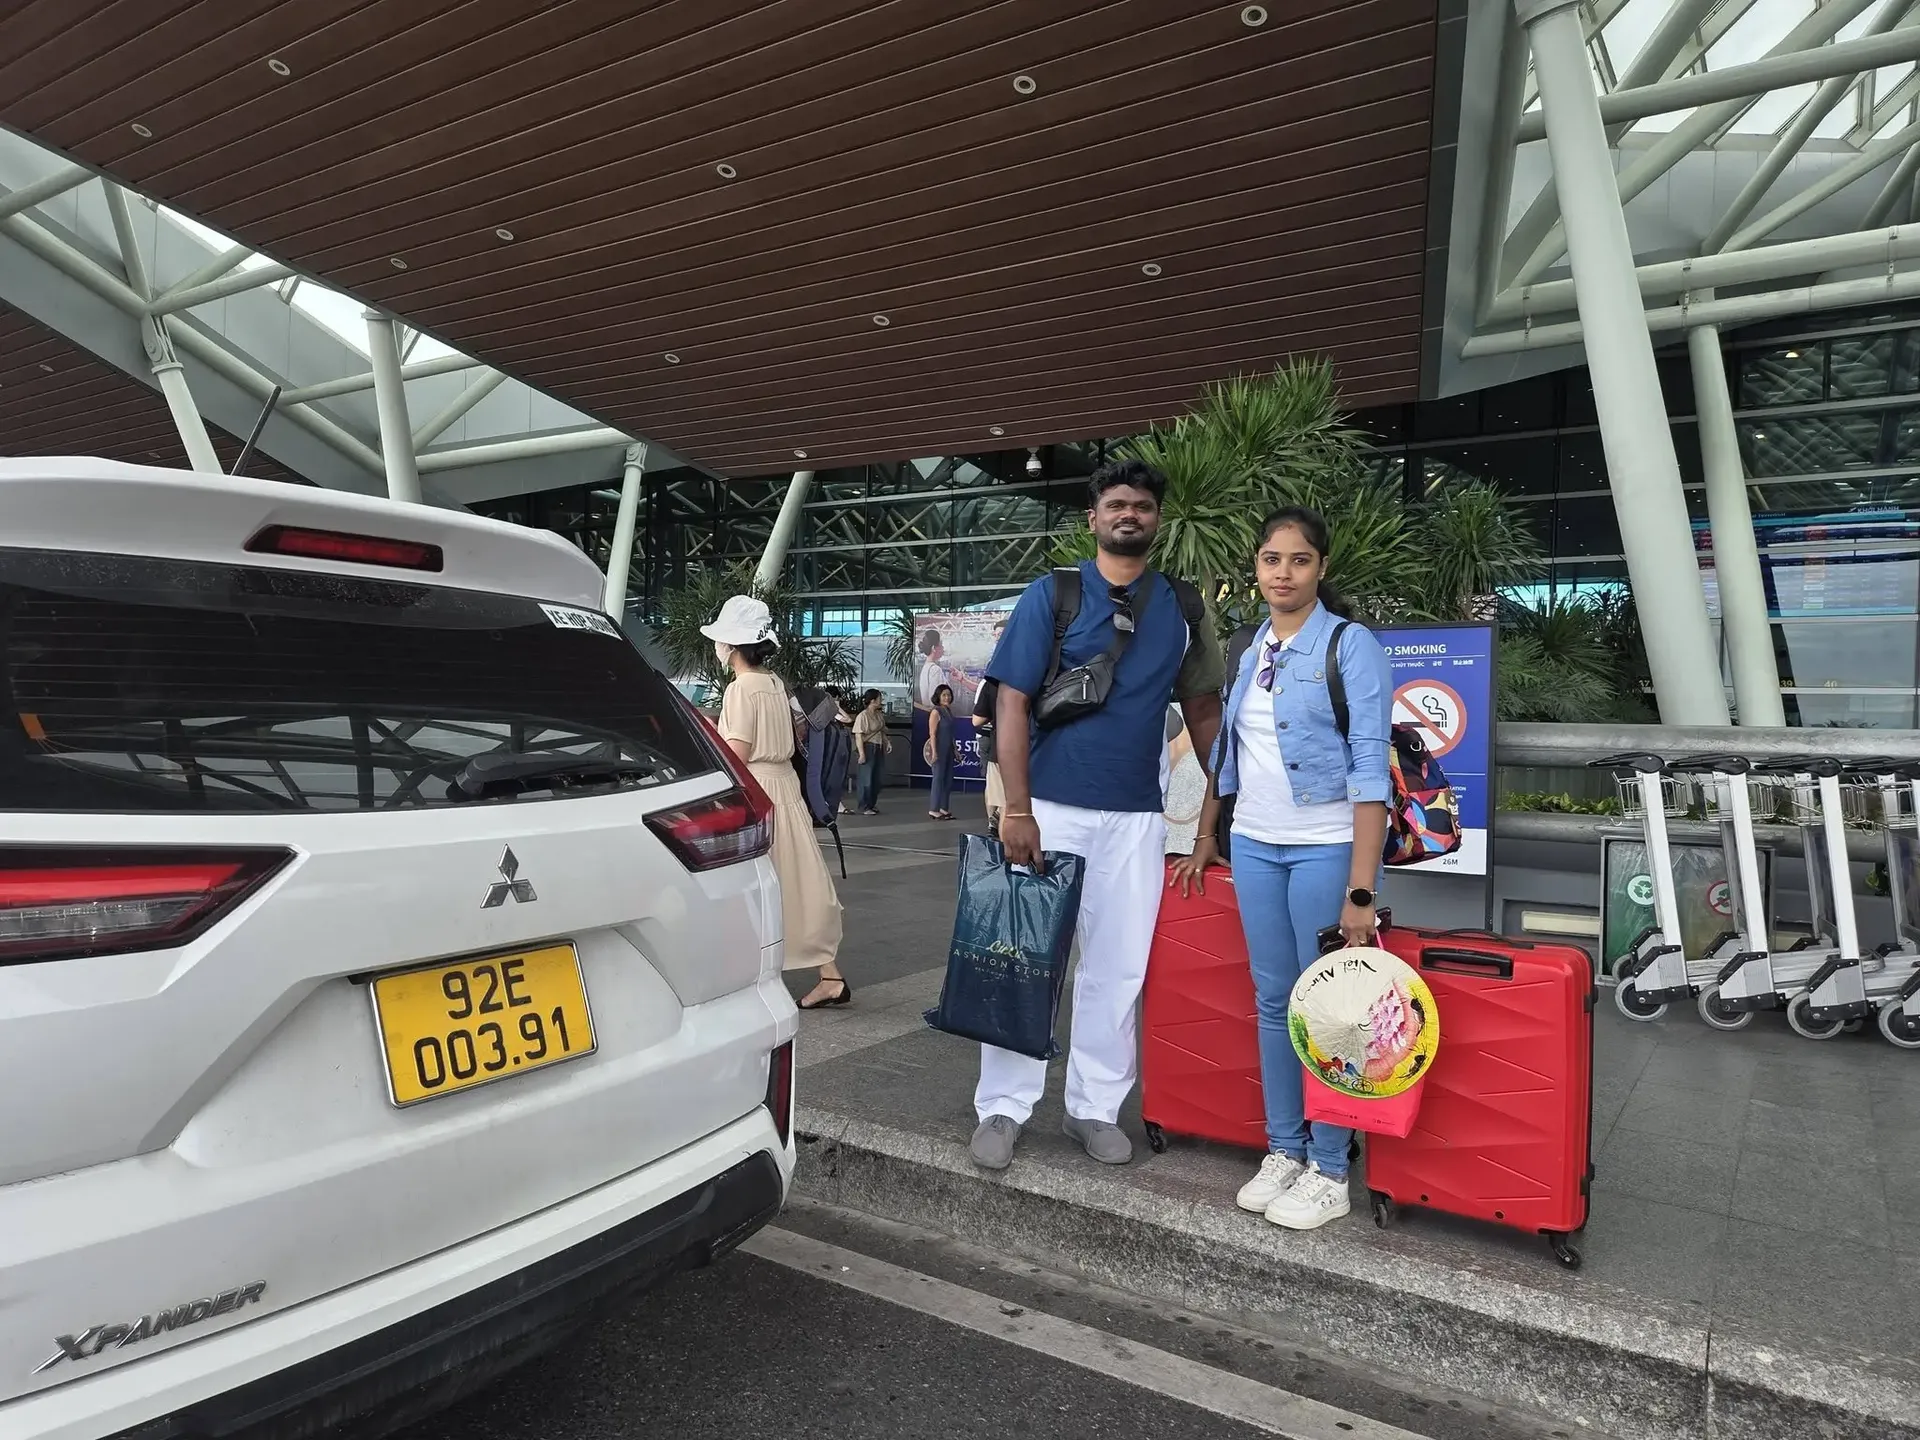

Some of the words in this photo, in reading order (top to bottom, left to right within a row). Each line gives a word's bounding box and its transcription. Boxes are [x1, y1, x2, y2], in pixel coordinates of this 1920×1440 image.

[546, 609, 567, 624] XE
[1384, 646, 1393, 656] O
[1395, 644, 1447, 656] SMOKING
[955, 739, 962, 752] 5
[953, 948, 1008, 969] ASHION
[442, 959, 531, 1021] 92E
[414, 1006, 571, 1089] 003.91
[31, 1279, 266, 1375] XPANDER
